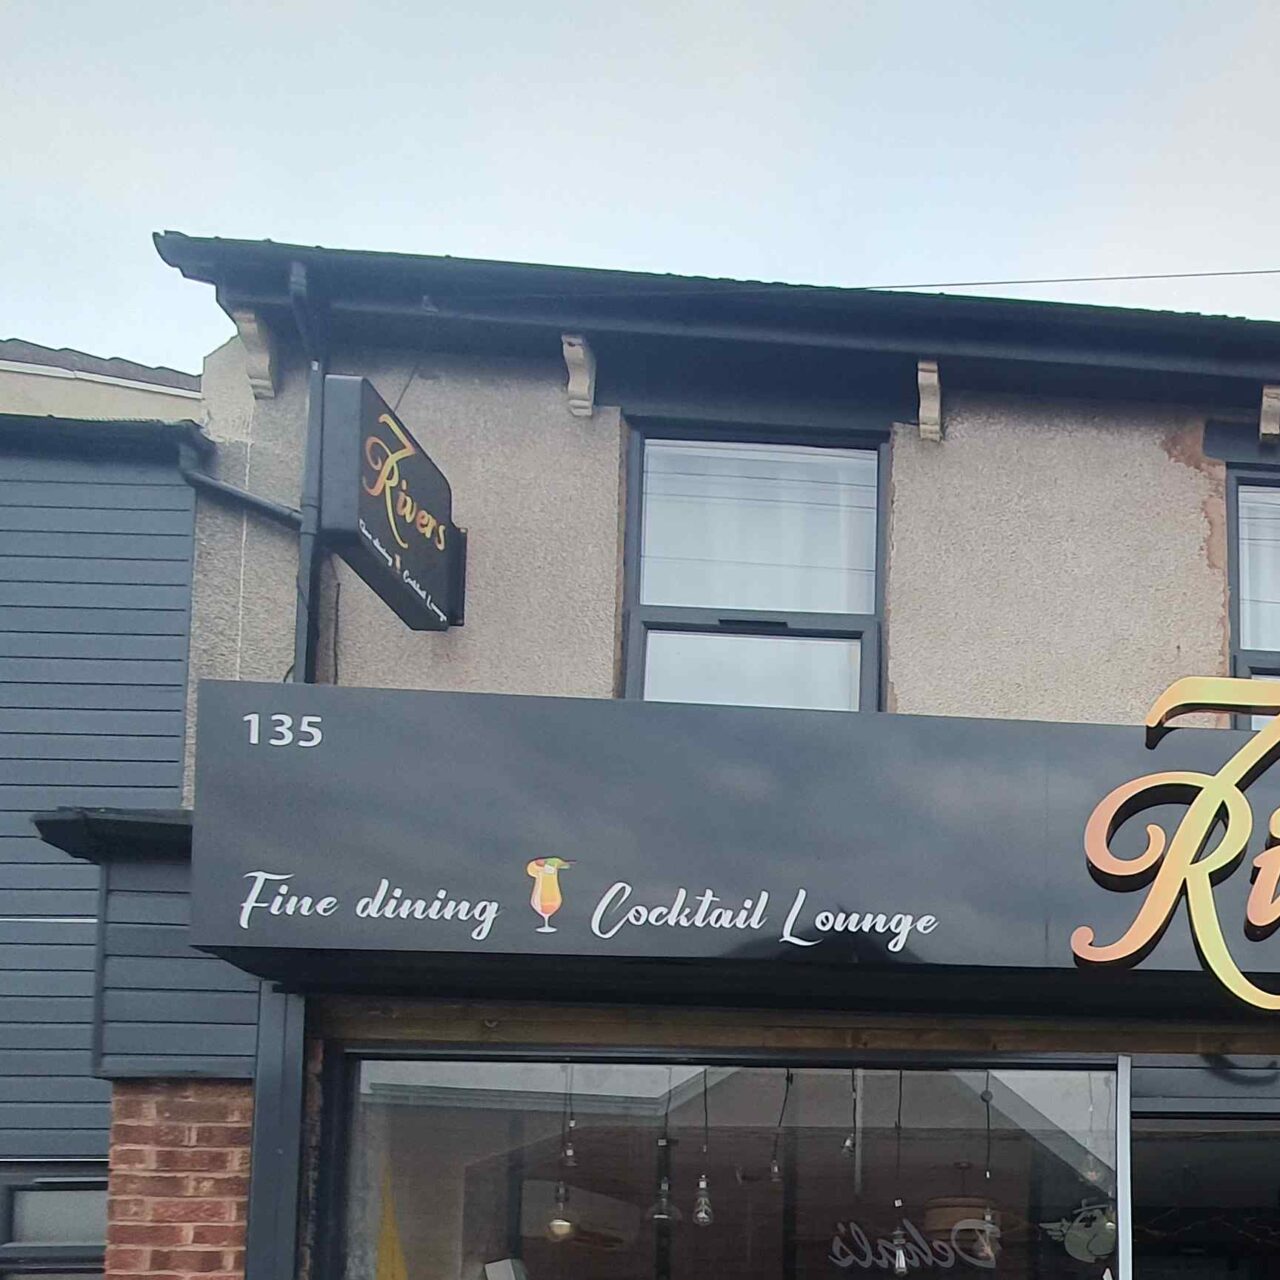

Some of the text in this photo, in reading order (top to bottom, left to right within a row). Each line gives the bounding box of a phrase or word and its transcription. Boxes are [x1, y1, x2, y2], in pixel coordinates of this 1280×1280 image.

[363, 436, 446, 551] Rivers
[242, 712, 324, 748] 135
[239, 871, 500, 941] Fine dining
[590, 882, 940, 952] Cocktail Lounge
